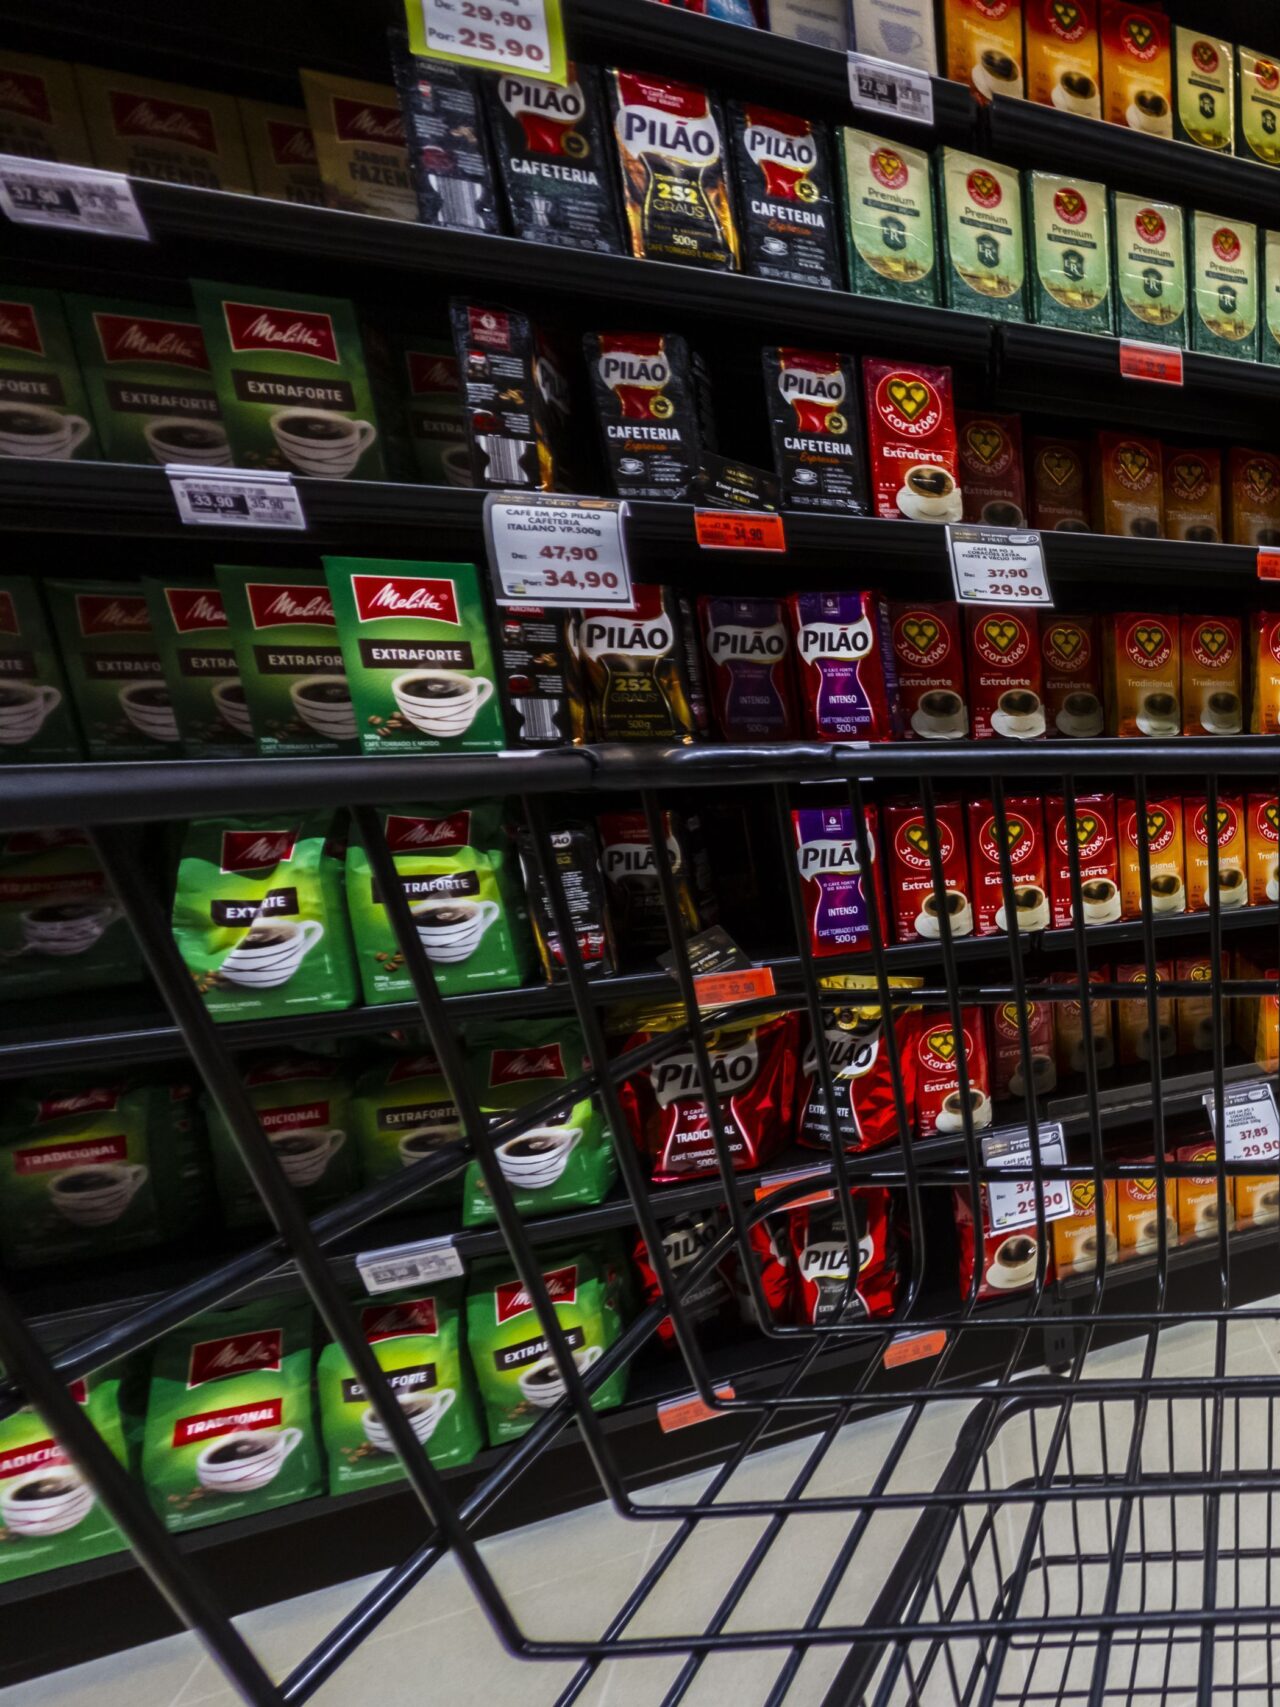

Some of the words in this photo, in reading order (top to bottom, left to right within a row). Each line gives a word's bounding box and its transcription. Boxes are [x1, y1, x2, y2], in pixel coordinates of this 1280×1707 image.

[462, 2, 532, 31] 29,90
[428, 27, 455, 43] Por:
[458, 28, 544, 61] 25,90
[504, 80, 581, 115] PILÃO
[348, 108, 403, 136] Meli
[625, 112, 715, 157] PILÃO
[749, 130, 813, 164] PILÃO
[349, 161, 412, 189] FAZEN
[510, 157, 599, 186] CAFETERIA
[657, 183, 699, 204] 252
[868, 188, 915, 206] Premium
[750, 201, 826, 229] CAFETERIA
[964, 207, 1008, 225] Premium
[1051, 224, 1093, 240] Premium
[1133, 244, 1171, 258] Premium
[1210, 262, 1245, 275] Premium
[245, 313, 323, 348] Melitta
[113, 324, 197, 359] Melitta
[604, 358, 667, 382] PILÃO
[247, 380, 343, 402] EXTRAFORTE
[783, 374, 842, 399] PILÃO
[120, 390, 217, 411] EXTRAFORTE
[881, 404, 892, 415] 3
[887, 410, 939, 435] corações
[607, 425, 681, 442] CAFETERIA
[783, 437, 853, 456] CAFETERIA
[882, 446, 944, 463] Extraforte
[193, 494, 234, 510] 33,90
[251, 497, 284, 511] 35,90
[506, 508, 531, 517] CAFÉ
[571, 511, 600, 520] PILÃO
[528, 517, 580, 526] CAFETERIA
[507, 523, 556, 533] ITALIANO
[511, 552, 527, 560] De:
[540, 546, 597, 562] 47,90
[522, 578, 542, 586] Por:
[543, 569, 618, 590] 34,90
[987, 569, 1028, 578] 37,90
[368, 582, 443, 613] Melitta
[989, 584, 1043, 597] 29,90
[586, 622, 669, 650] PILÃO
[713, 630, 785, 655] PILÃO
[803, 627, 869, 652] PILÃO
[268, 653, 344, 668] EXTRAFOR
[372, 648, 463, 662] EXTRAFORTE
[903, 642, 947, 665] corações
[985, 643, 1026, 665] corações
[1134, 647, 1171, 667] corações
[96, 659, 162, 672] EXTRAFO
[190, 657, 238, 670] EXTRA
[615, 677, 653, 692] 252
[899, 676, 952, 688] Extraforte
[980, 676, 1031, 688] Extraforte
[1127, 678, 1174, 688] Tradicional
[828, 695, 857, 705] INTENSO
[836, 723, 857, 735] 500g
[802, 843, 860, 869] PILÃ
[404, 878, 470, 894] TRAFORTE
[902, 877, 957, 891] Extrafte
[828, 906, 858, 917] INTENSO
[835, 934, 857, 944] 500g
[264, 1108, 321, 1127] DICIONAL
[385, 1107, 460, 1124] EXTRAFORTE
[1240, 1127, 1268, 1140] 37,89
[25, 1144, 118, 1167] TRADICIONAL
[1243, 1140, 1280, 1157] 29,90
[504, 1334, 576, 1364] EXTRAFTE
[186, 1407, 275, 1435] TRADICIONAL
